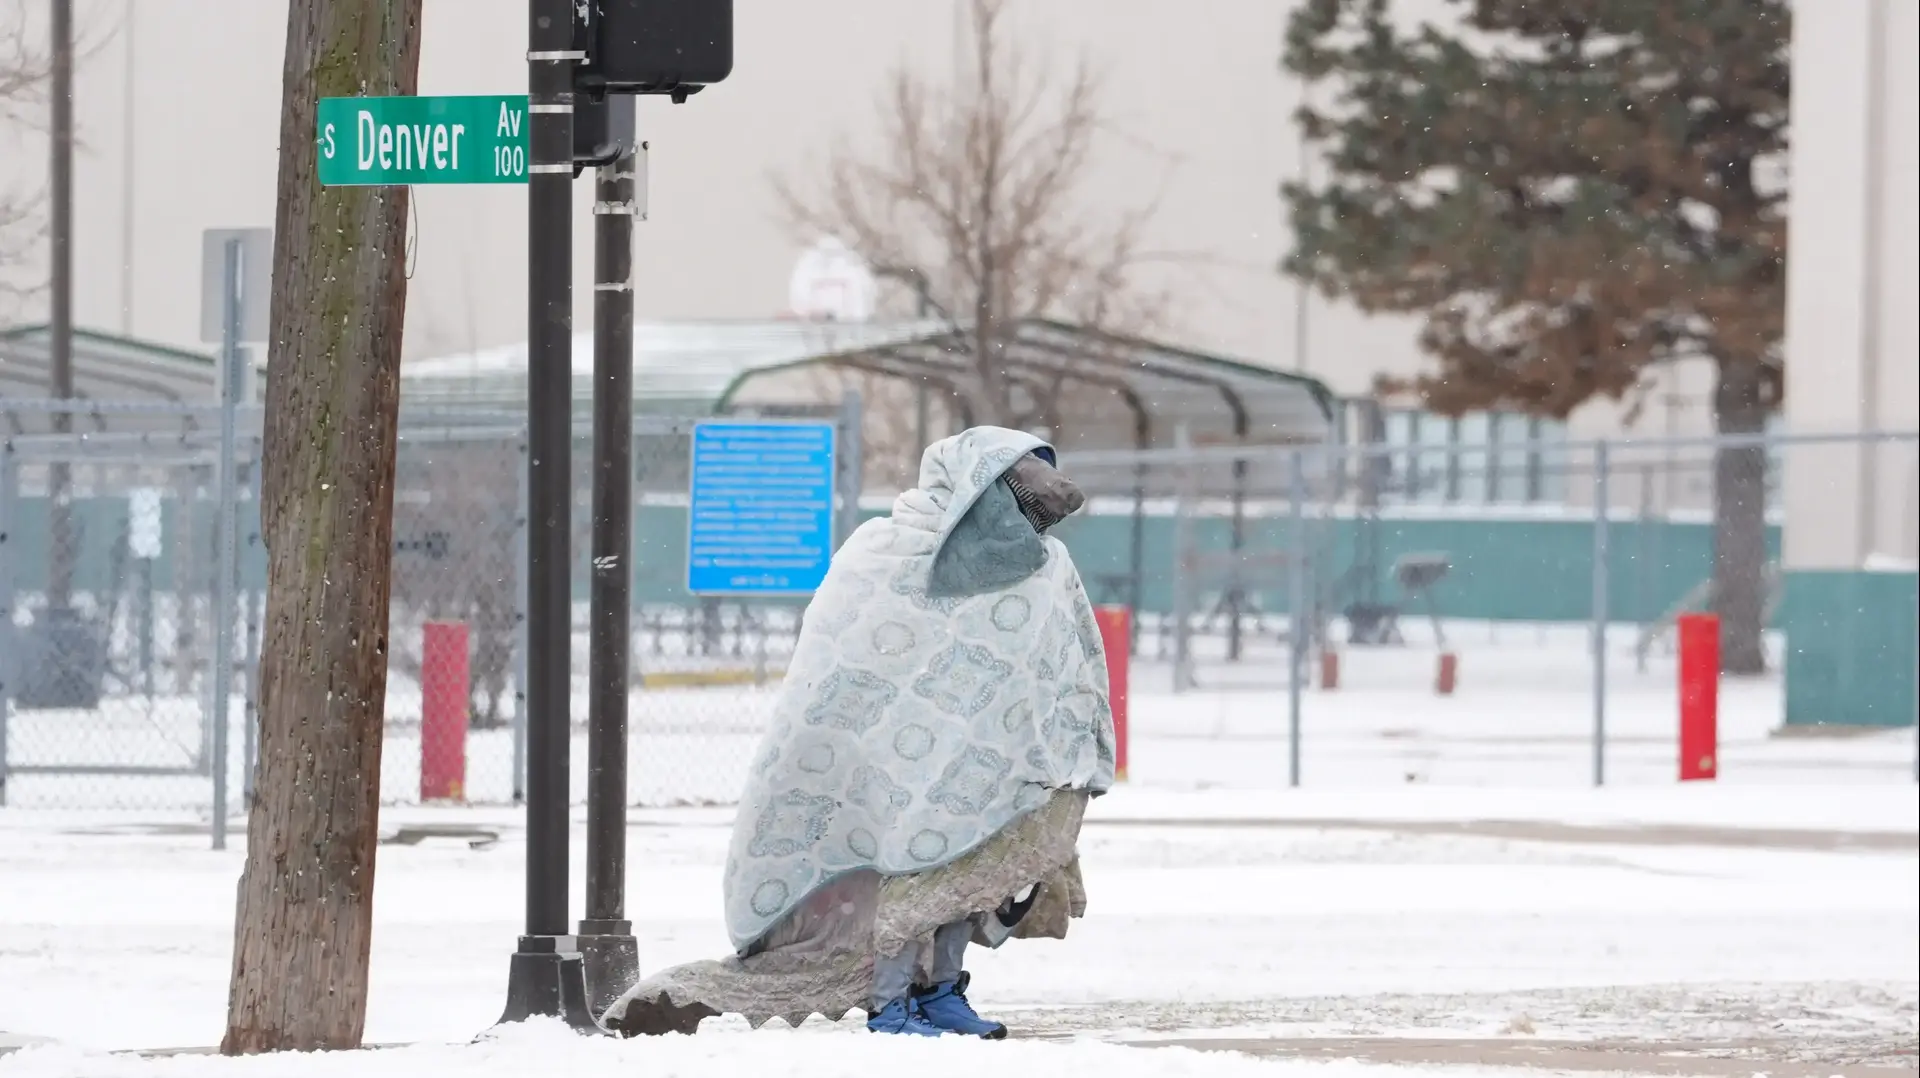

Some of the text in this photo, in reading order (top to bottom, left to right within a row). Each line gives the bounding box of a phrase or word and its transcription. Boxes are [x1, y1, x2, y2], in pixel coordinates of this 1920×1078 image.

[324, 101, 522, 170] S Denver Av
[494, 145, 524, 177] 100
